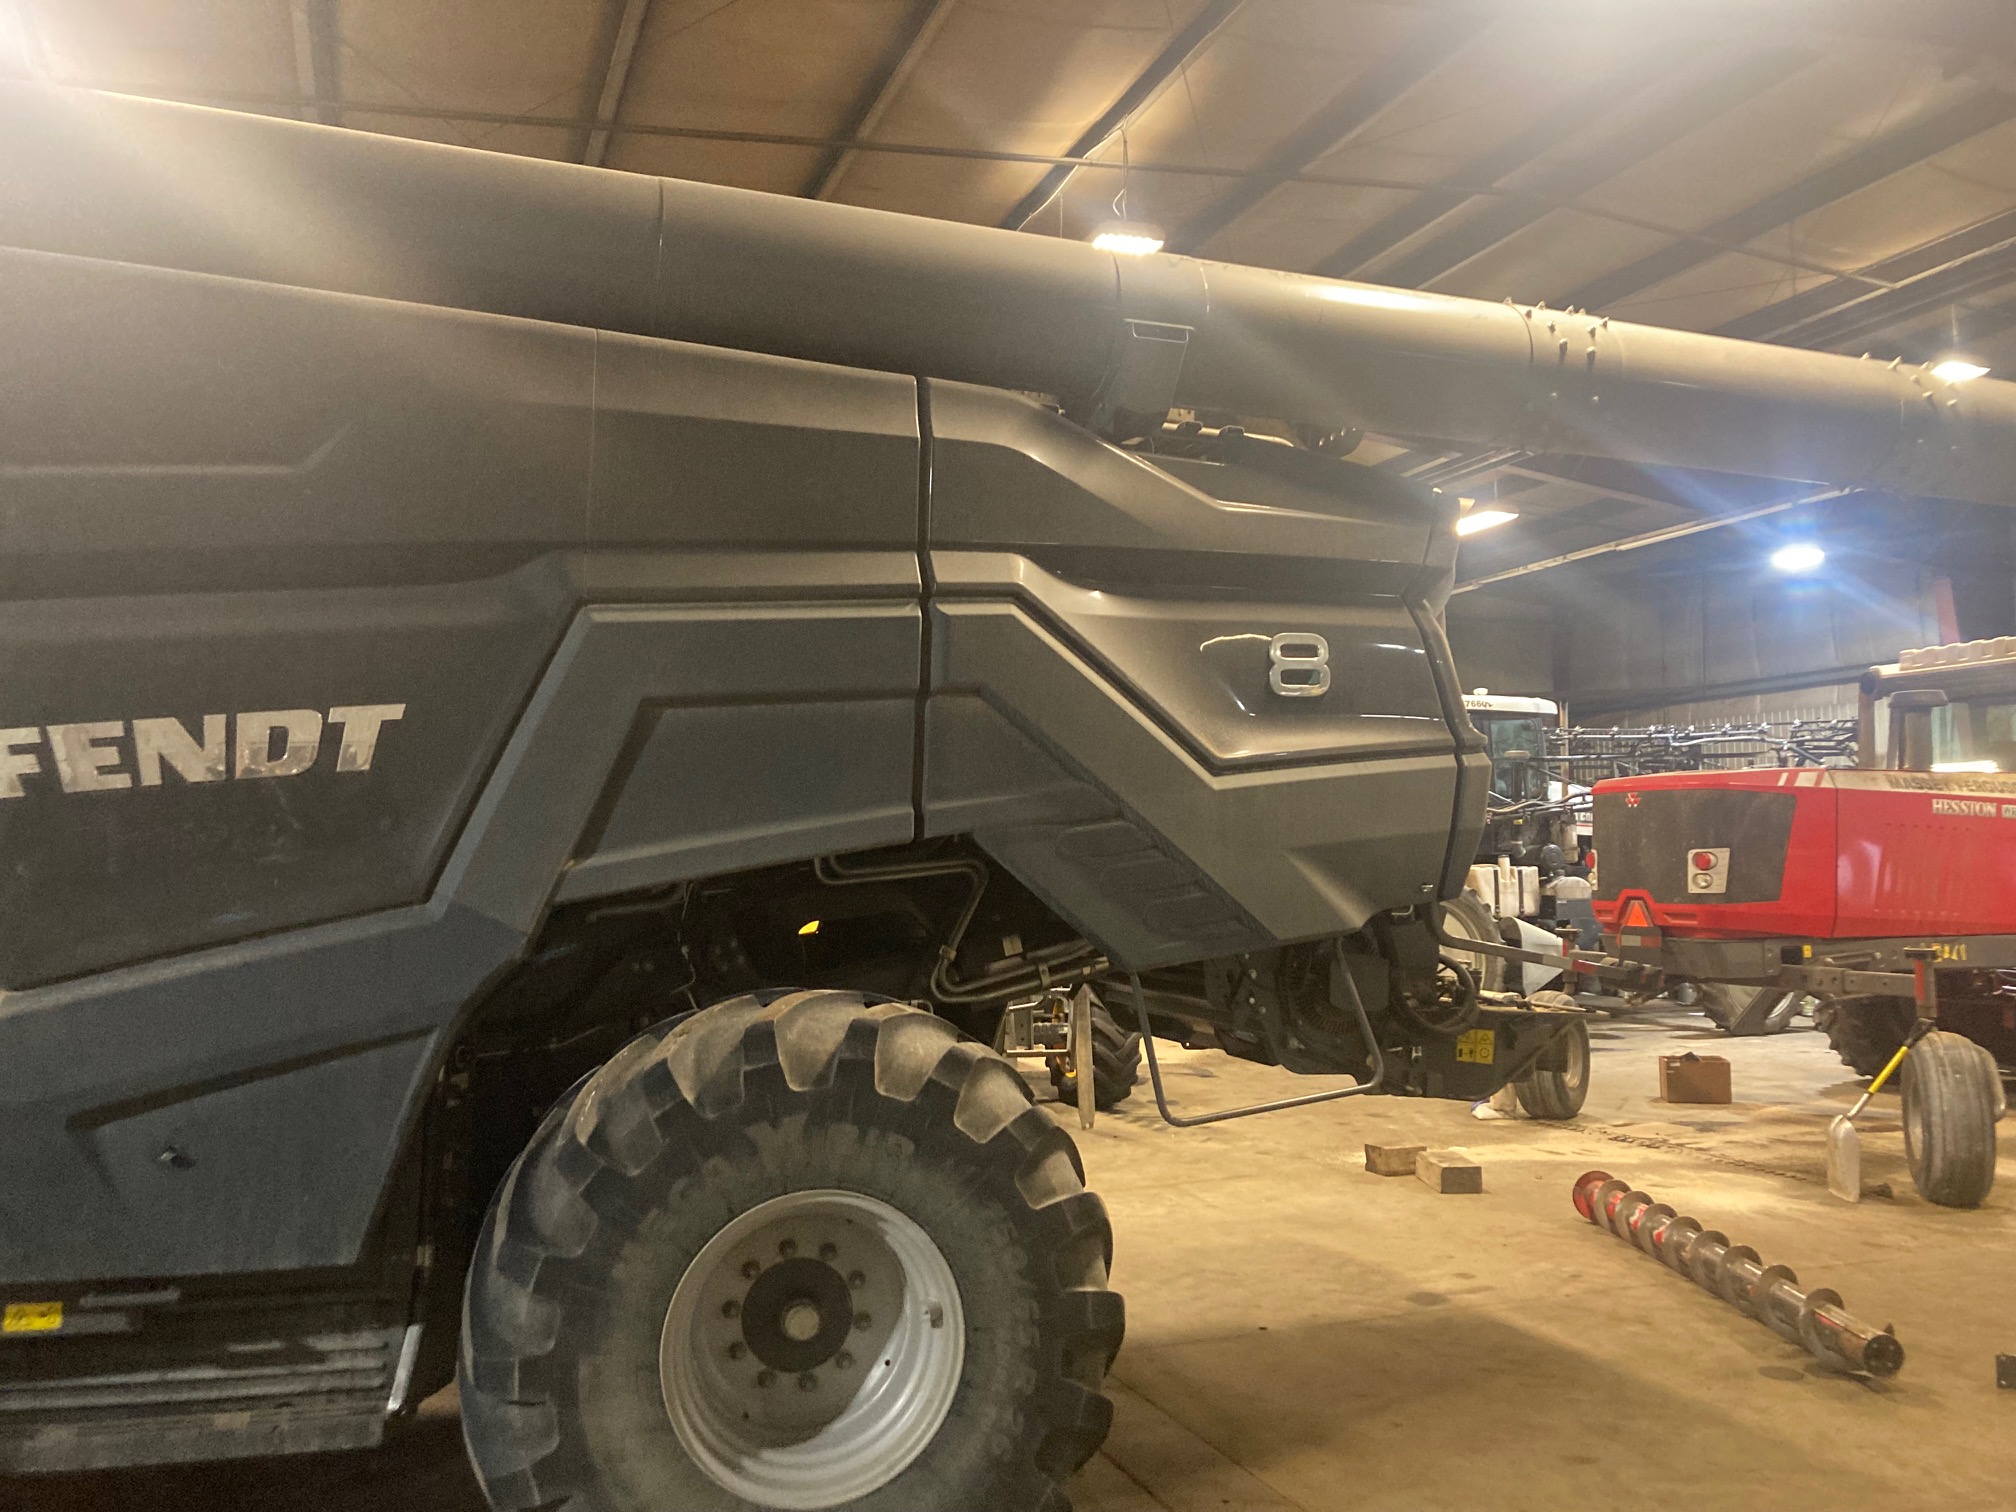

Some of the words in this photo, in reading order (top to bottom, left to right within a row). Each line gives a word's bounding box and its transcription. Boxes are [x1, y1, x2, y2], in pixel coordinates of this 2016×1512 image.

[1269, 632, 1331, 697] 8
[0, 703, 406, 799] FENDT
[1932, 798, 1997, 817] HESSTON
